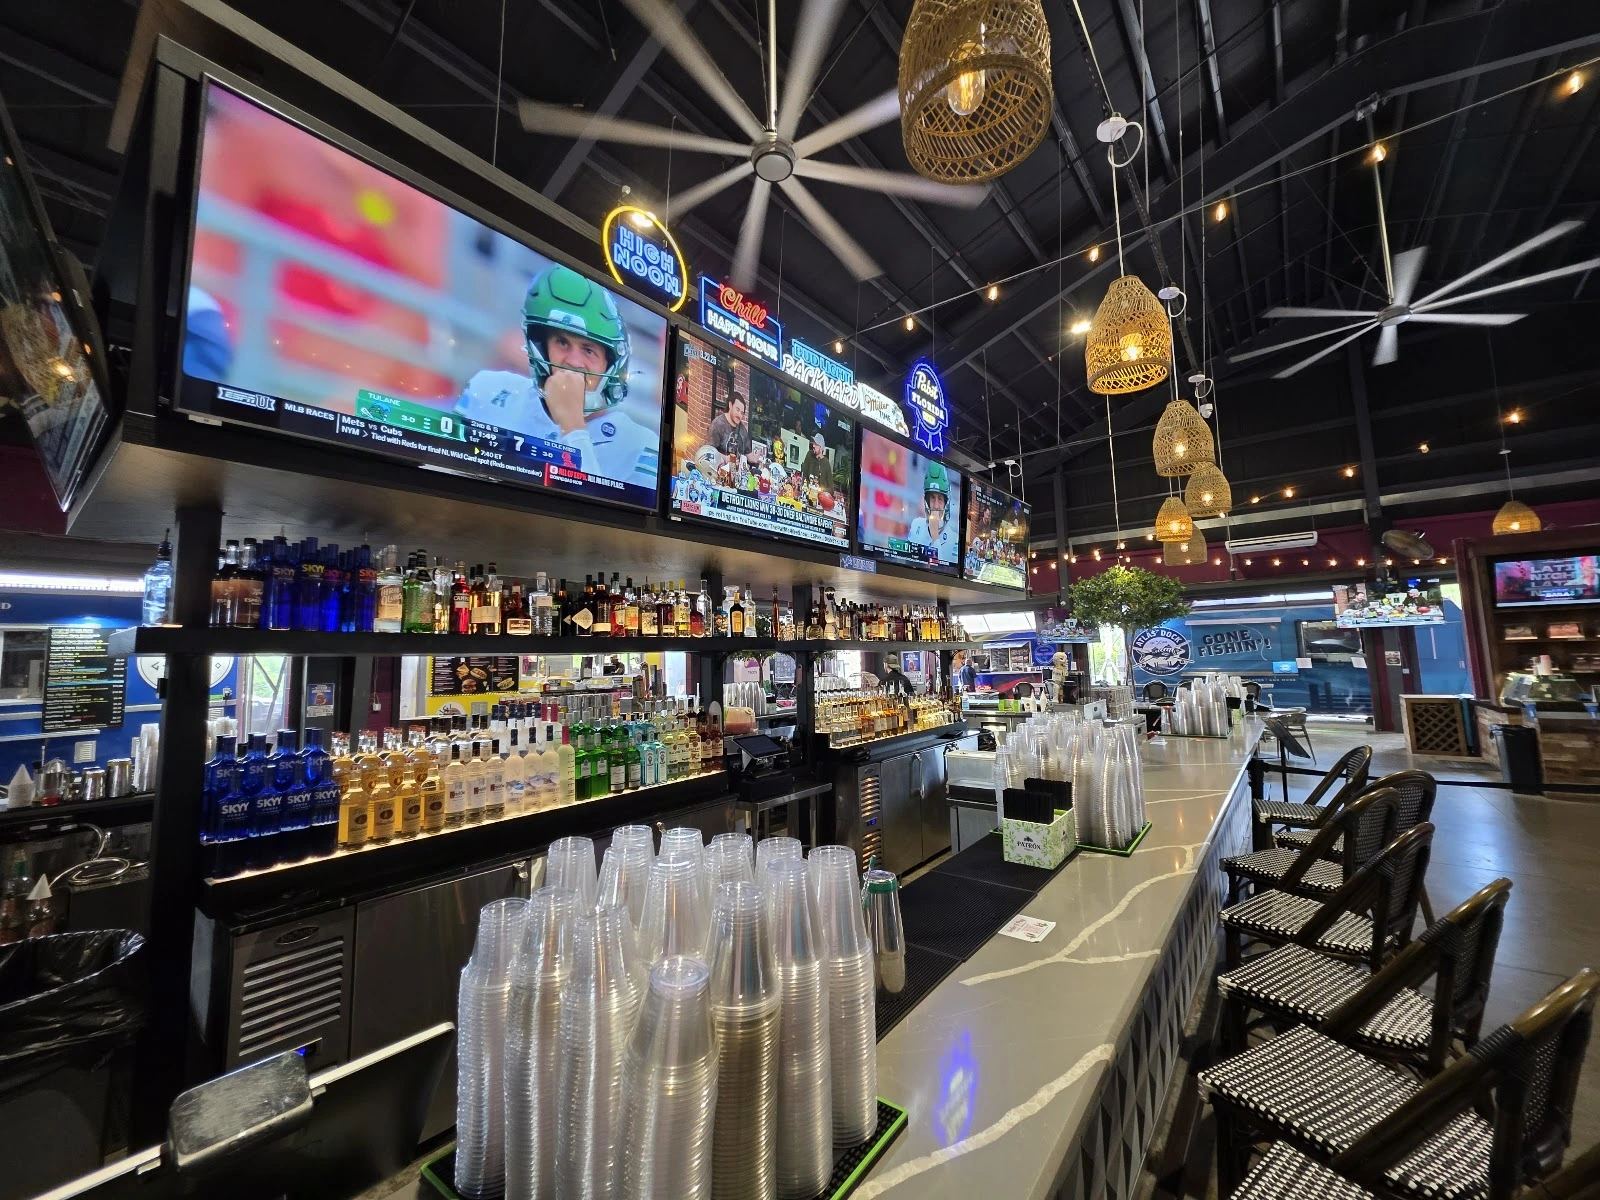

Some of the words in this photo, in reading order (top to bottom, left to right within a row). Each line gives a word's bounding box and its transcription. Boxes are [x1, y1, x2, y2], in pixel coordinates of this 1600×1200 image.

[619, 225, 674, 275] HIGH
[718, 284, 767, 329] Chill
[707, 308, 746, 342] HAPPY
[746, 331, 779, 362] HOUR
[794, 342, 820, 367] BUD
[819, 356, 852, 386] LIGHT
[781, 353, 860, 410] BACKYARD
[915, 370, 940, 400] Pabst
[368, 392, 401, 407] TULANE
[865, 394, 889, 412] Miller
[911, 391, 945, 421] FLORIDA
[284, 402, 305, 414] MLB
[305, 408, 335, 421] RACES
[341, 415, 366, 428] Mets
[368, 422, 378, 431] vs
[380, 425, 403, 437] Cubs
[440, 416, 453, 434] 0
[341, 425, 360, 436] NYM
[371, 432, 387, 442] Tied
[386, 435, 401, 446] with
[401, 439, 418, 449] Reds
[418, 443, 428, 451] for
[463, 453, 477, 462] Card
[471, 429, 497, 441] 11:49
[513, 435, 525, 452] 7
[480, 449, 494, 458] 7:40
[715, 511, 732, 521] rolling
[721, 492, 744, 507] DETROIT
[744, 497, 760, 511] LIONS
[759, 501, 769, 513] WIN
[783, 508, 796, 520] OVER
[795, 511, 819, 526] BALTIMORE
[817, 518, 833, 530] RAVENS
[273, 566, 296, 577] SKYY
[302, 563, 325, 574] SKYY
[1160, 629, 1183, 643] DOCK
[1202, 629, 1252, 646] GONE
[256, 795, 282, 808] SKYY
[287, 792, 312, 804] SKYY
[313, 790, 338, 800] SKYY
[221, 801, 250, 815] SKYY
[1016, 840, 1041, 850] PATRÓN
